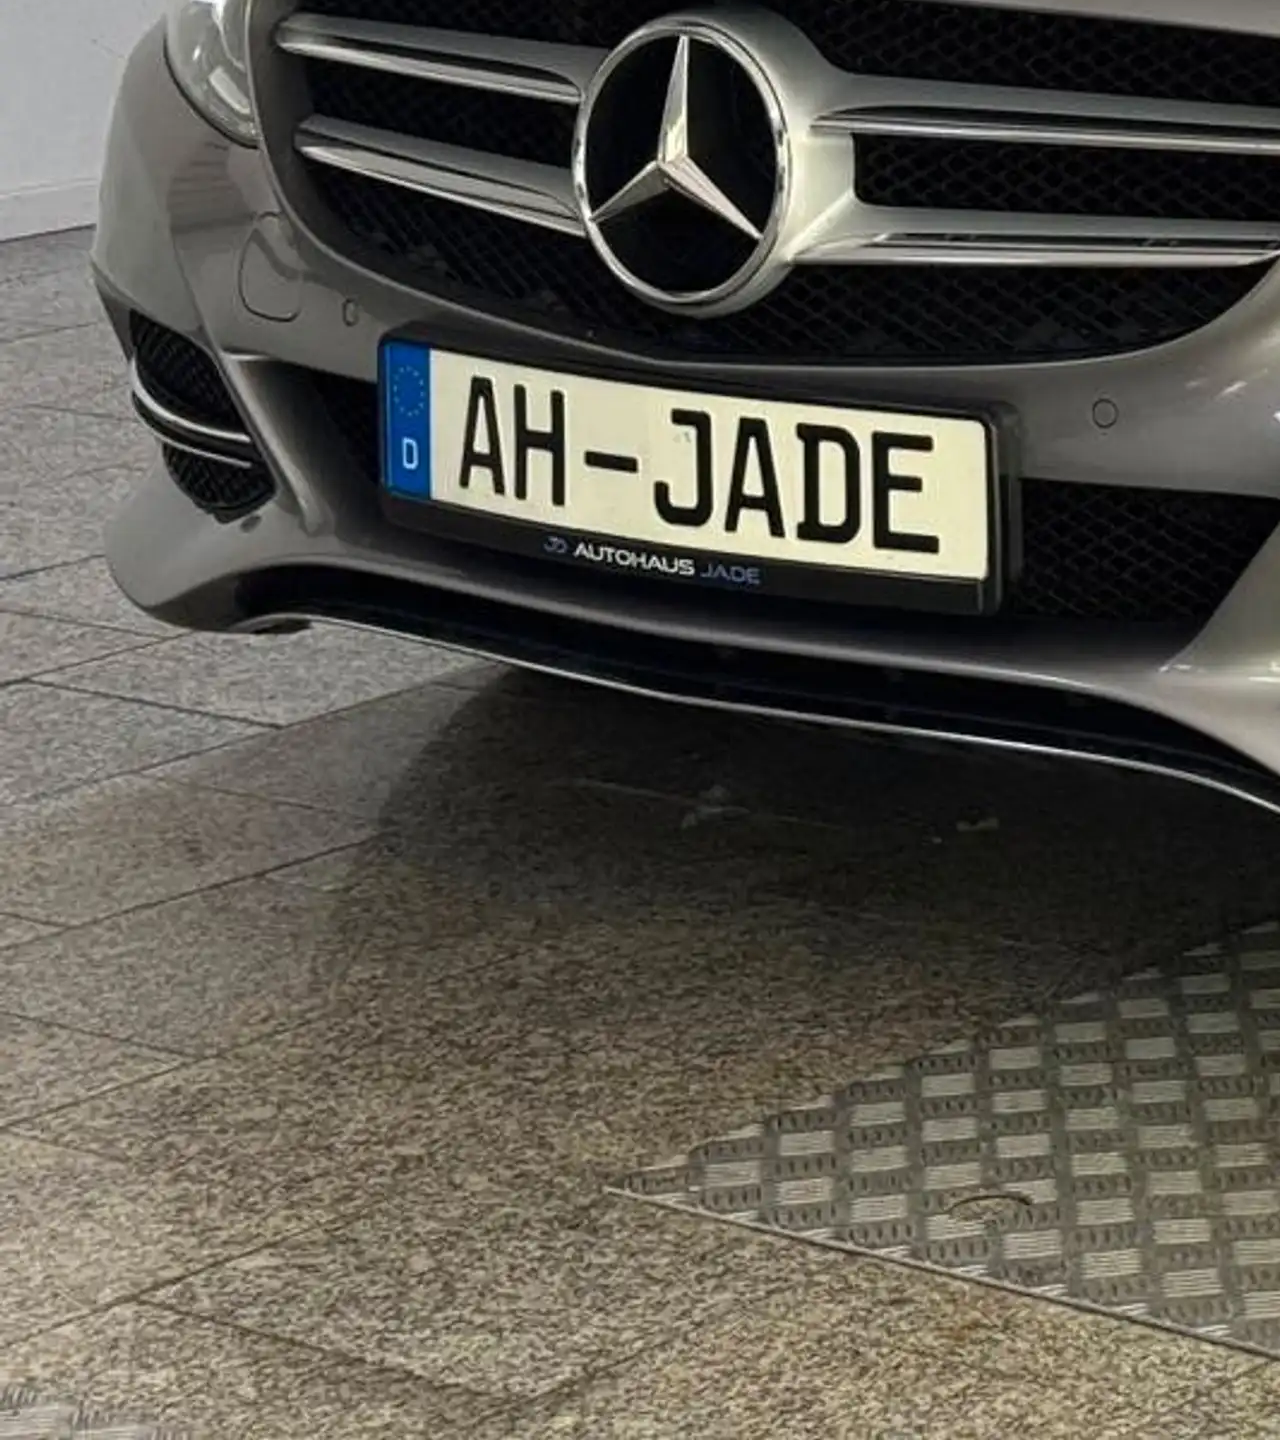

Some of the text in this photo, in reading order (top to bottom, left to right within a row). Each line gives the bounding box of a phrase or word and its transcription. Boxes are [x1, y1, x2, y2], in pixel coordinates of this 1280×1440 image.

[402, 437, 419, 470] D
[459, 376, 940, 554] AH-JADE
[573, 541, 696, 576] AUTOHAUS
[701, 563, 761, 585] JADE
